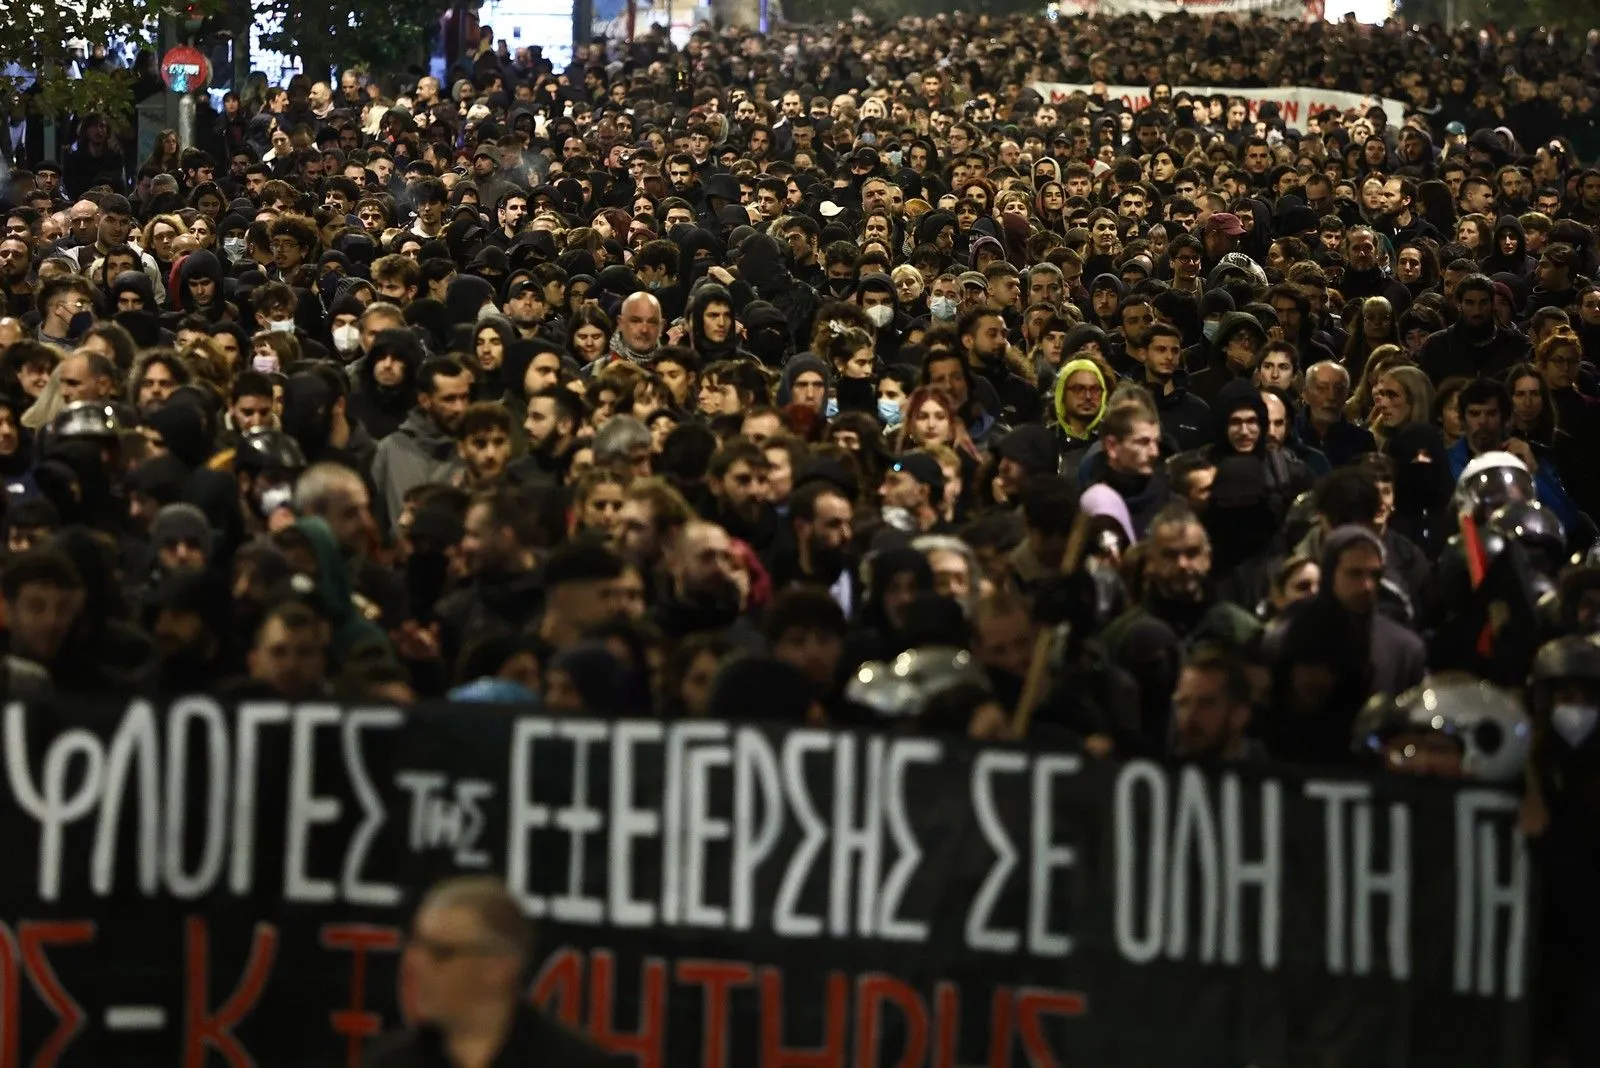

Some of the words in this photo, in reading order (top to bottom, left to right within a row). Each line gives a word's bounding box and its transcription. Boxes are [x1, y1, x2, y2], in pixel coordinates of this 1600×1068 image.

[395, 770, 496, 867] ΤΗΣ
[507, 717, 942, 941] ΕΞΕΓΕΡΣΗΣ
[965, 749, 1081, 956] ΣΕ
[1114, 758, 1282, 971] ΟΛΗ
[1304, 779, 1412, 980] ΤΗ
[1454, 788, 1530, 1000] ΓΗ
